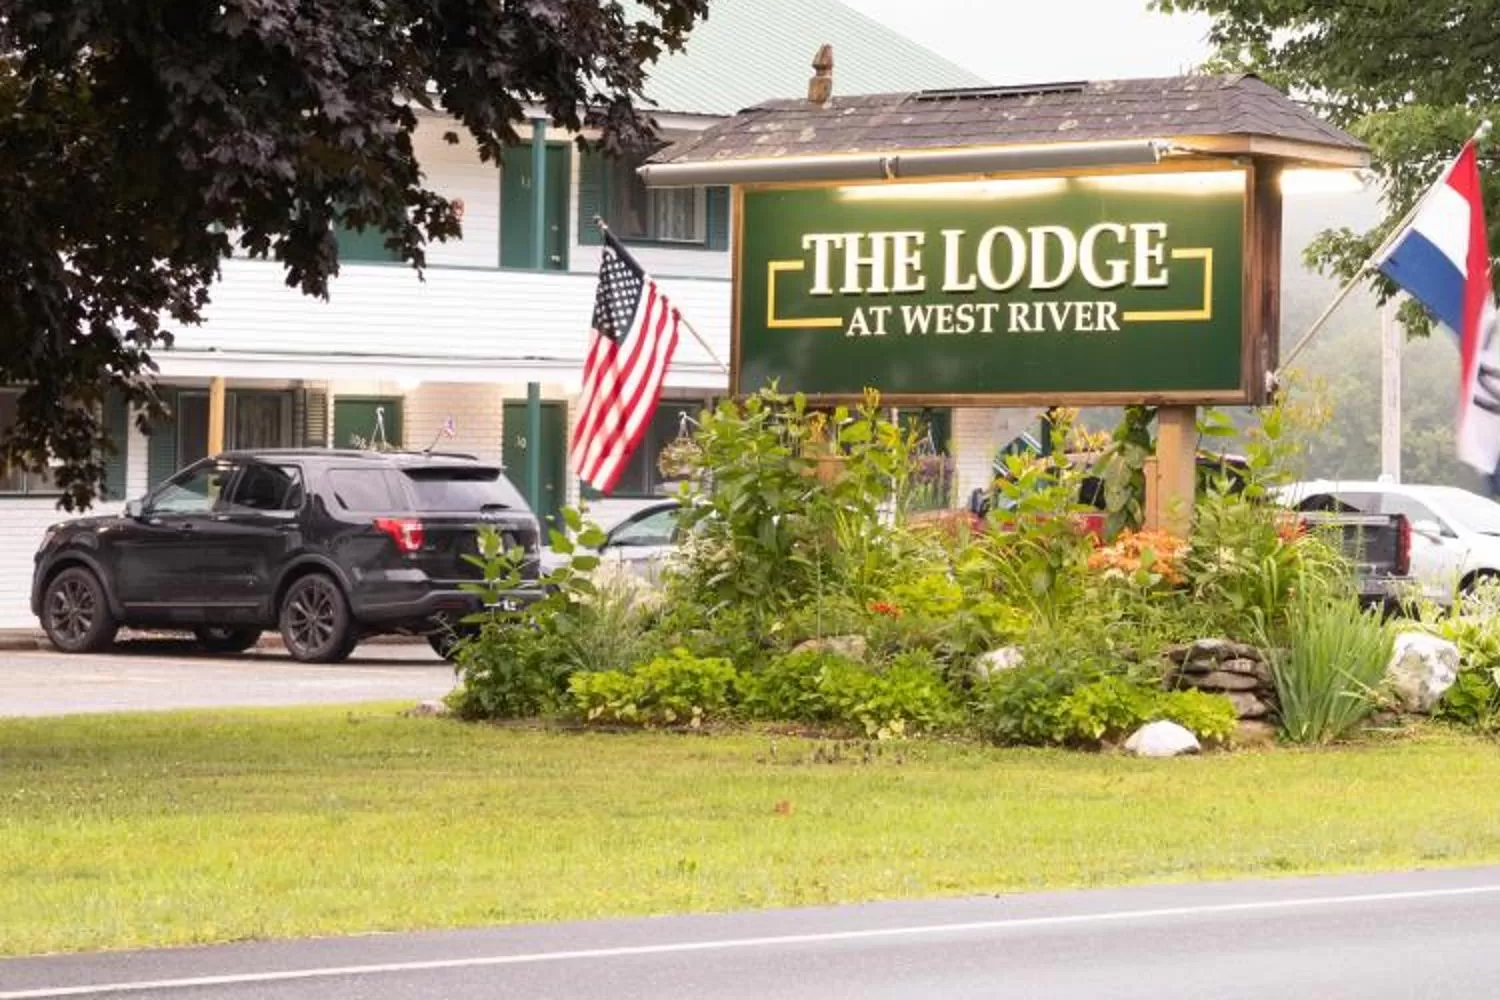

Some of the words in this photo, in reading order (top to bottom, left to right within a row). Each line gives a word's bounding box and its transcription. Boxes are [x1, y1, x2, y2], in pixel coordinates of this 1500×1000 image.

[802, 231, 926, 294] THE
[941, 222, 1169, 291] LODGE
[846, 306, 892, 336] AT
[901, 303, 999, 335] WEST
[1007, 301, 1120, 333] RIVER
